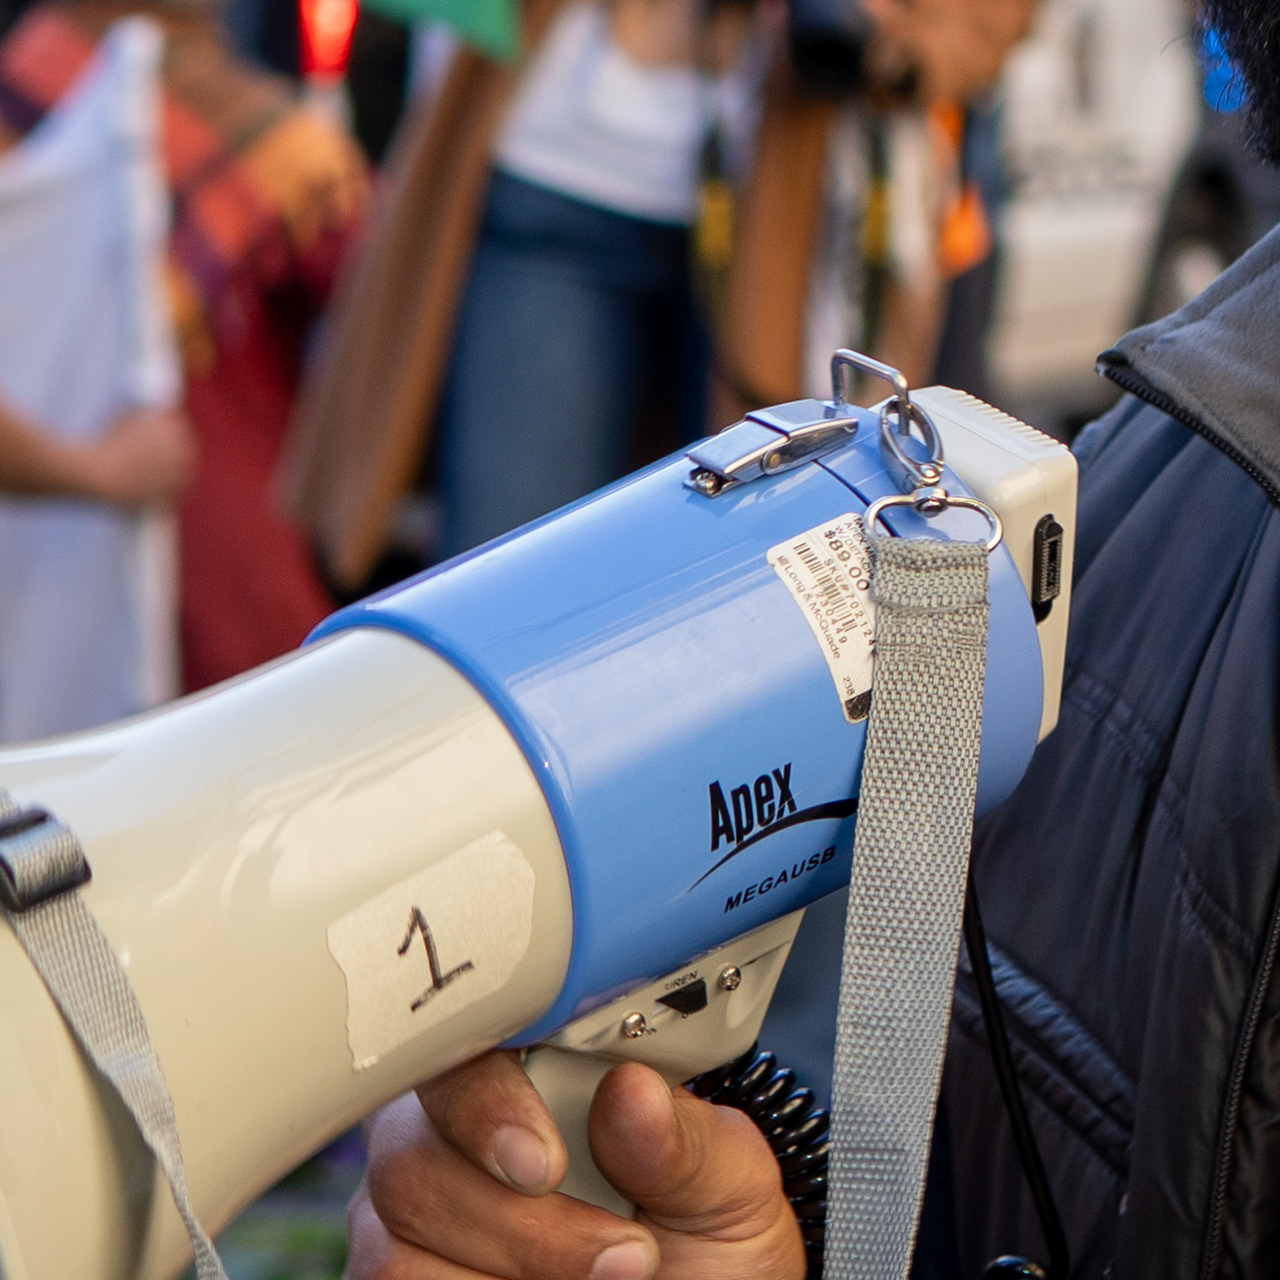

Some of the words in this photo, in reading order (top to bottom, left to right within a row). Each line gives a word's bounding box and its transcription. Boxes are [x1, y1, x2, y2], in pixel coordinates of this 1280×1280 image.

[824, 530, 870, 591] $89.00
[835, 525, 874, 580] W/DETACH
[784, 565, 806, 593] Long
[809, 601, 841, 659] McQuade
[811, 584, 848, 644] 1230449
[709, 762, 797, 852] Apex
[724, 845, 837, 913] MEGAUSB
[396, 906, 475, 1013] 1
